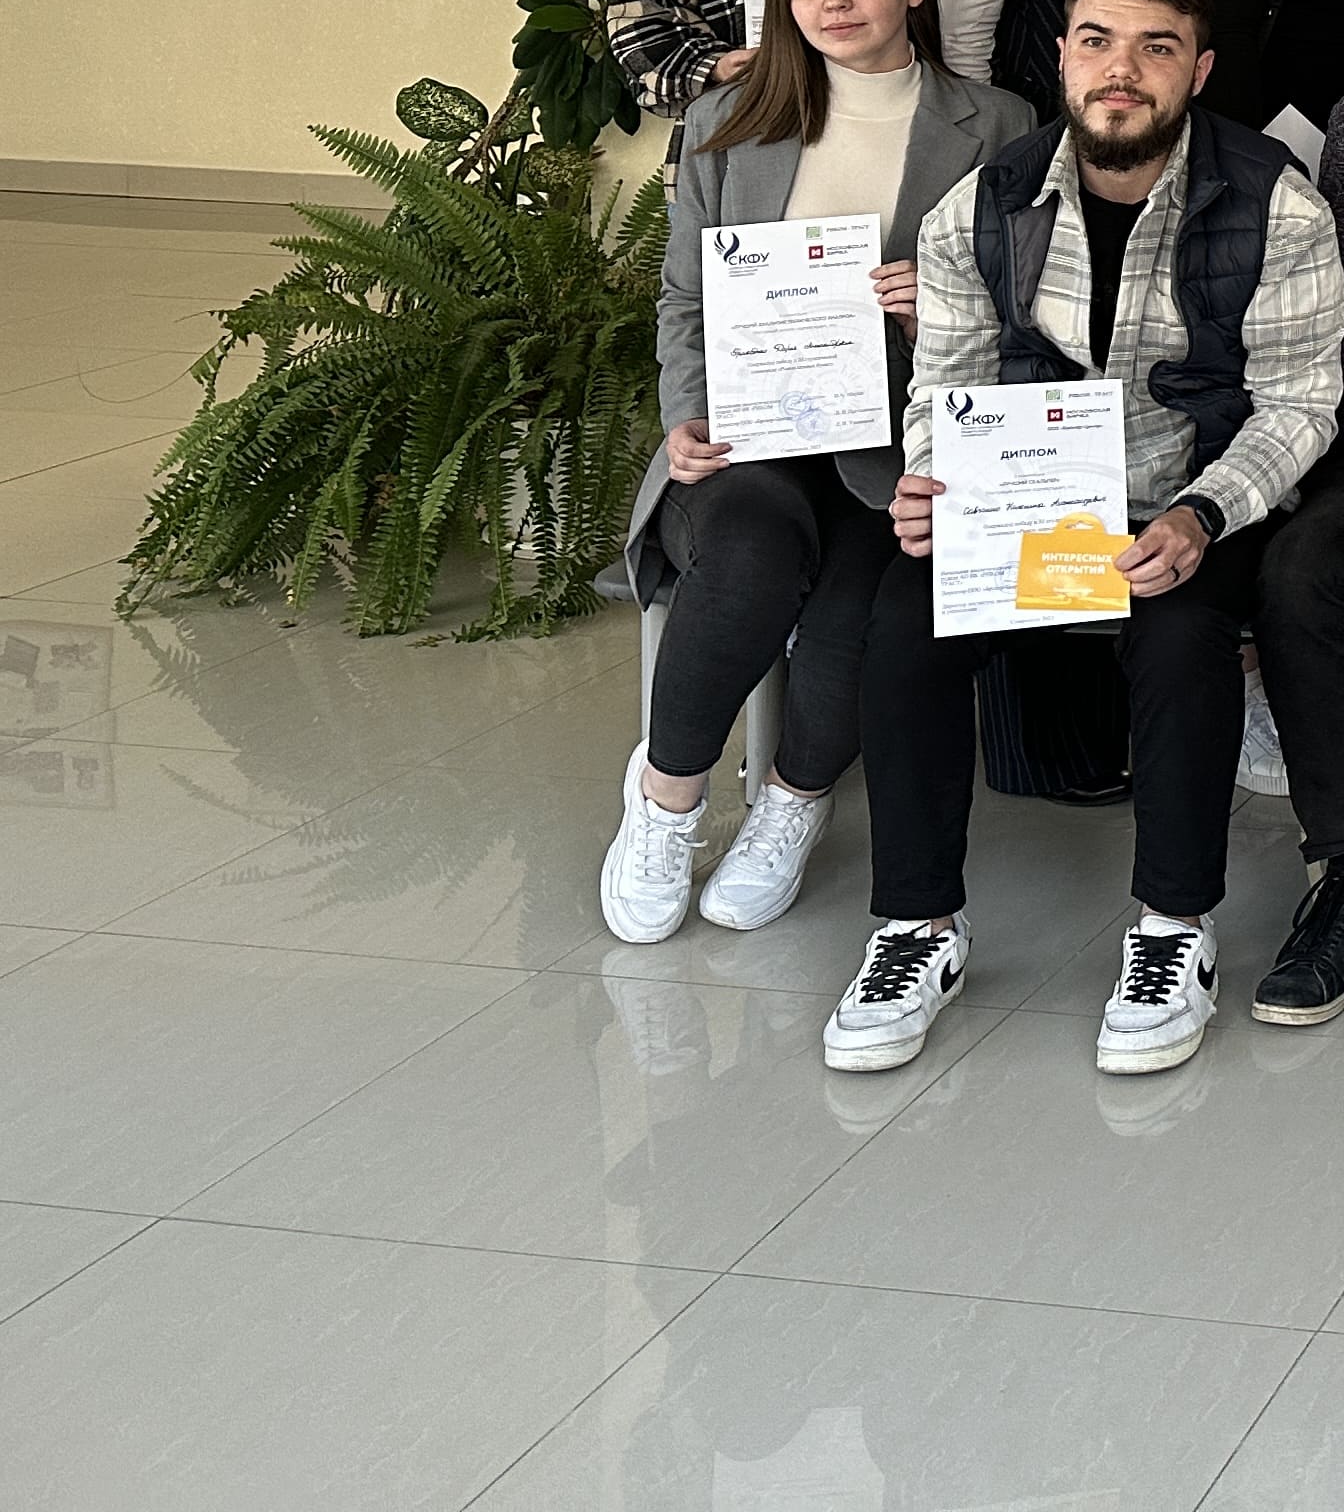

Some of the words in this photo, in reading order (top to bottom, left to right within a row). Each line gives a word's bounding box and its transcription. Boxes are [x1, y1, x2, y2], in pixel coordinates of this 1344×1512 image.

[729, 252, 770, 265] СКФУ
[766, 286, 818, 300] ДИПЛОМ
[961, 413, 1006, 426] СКФУ
[1000, 448, 1058, 461] ДИПЛОМ
[1041, 552, 1113, 563] ИНТЕРЕСНЫХ
[1045, 564, 1106, 575] ОТКРЫТИЙ
